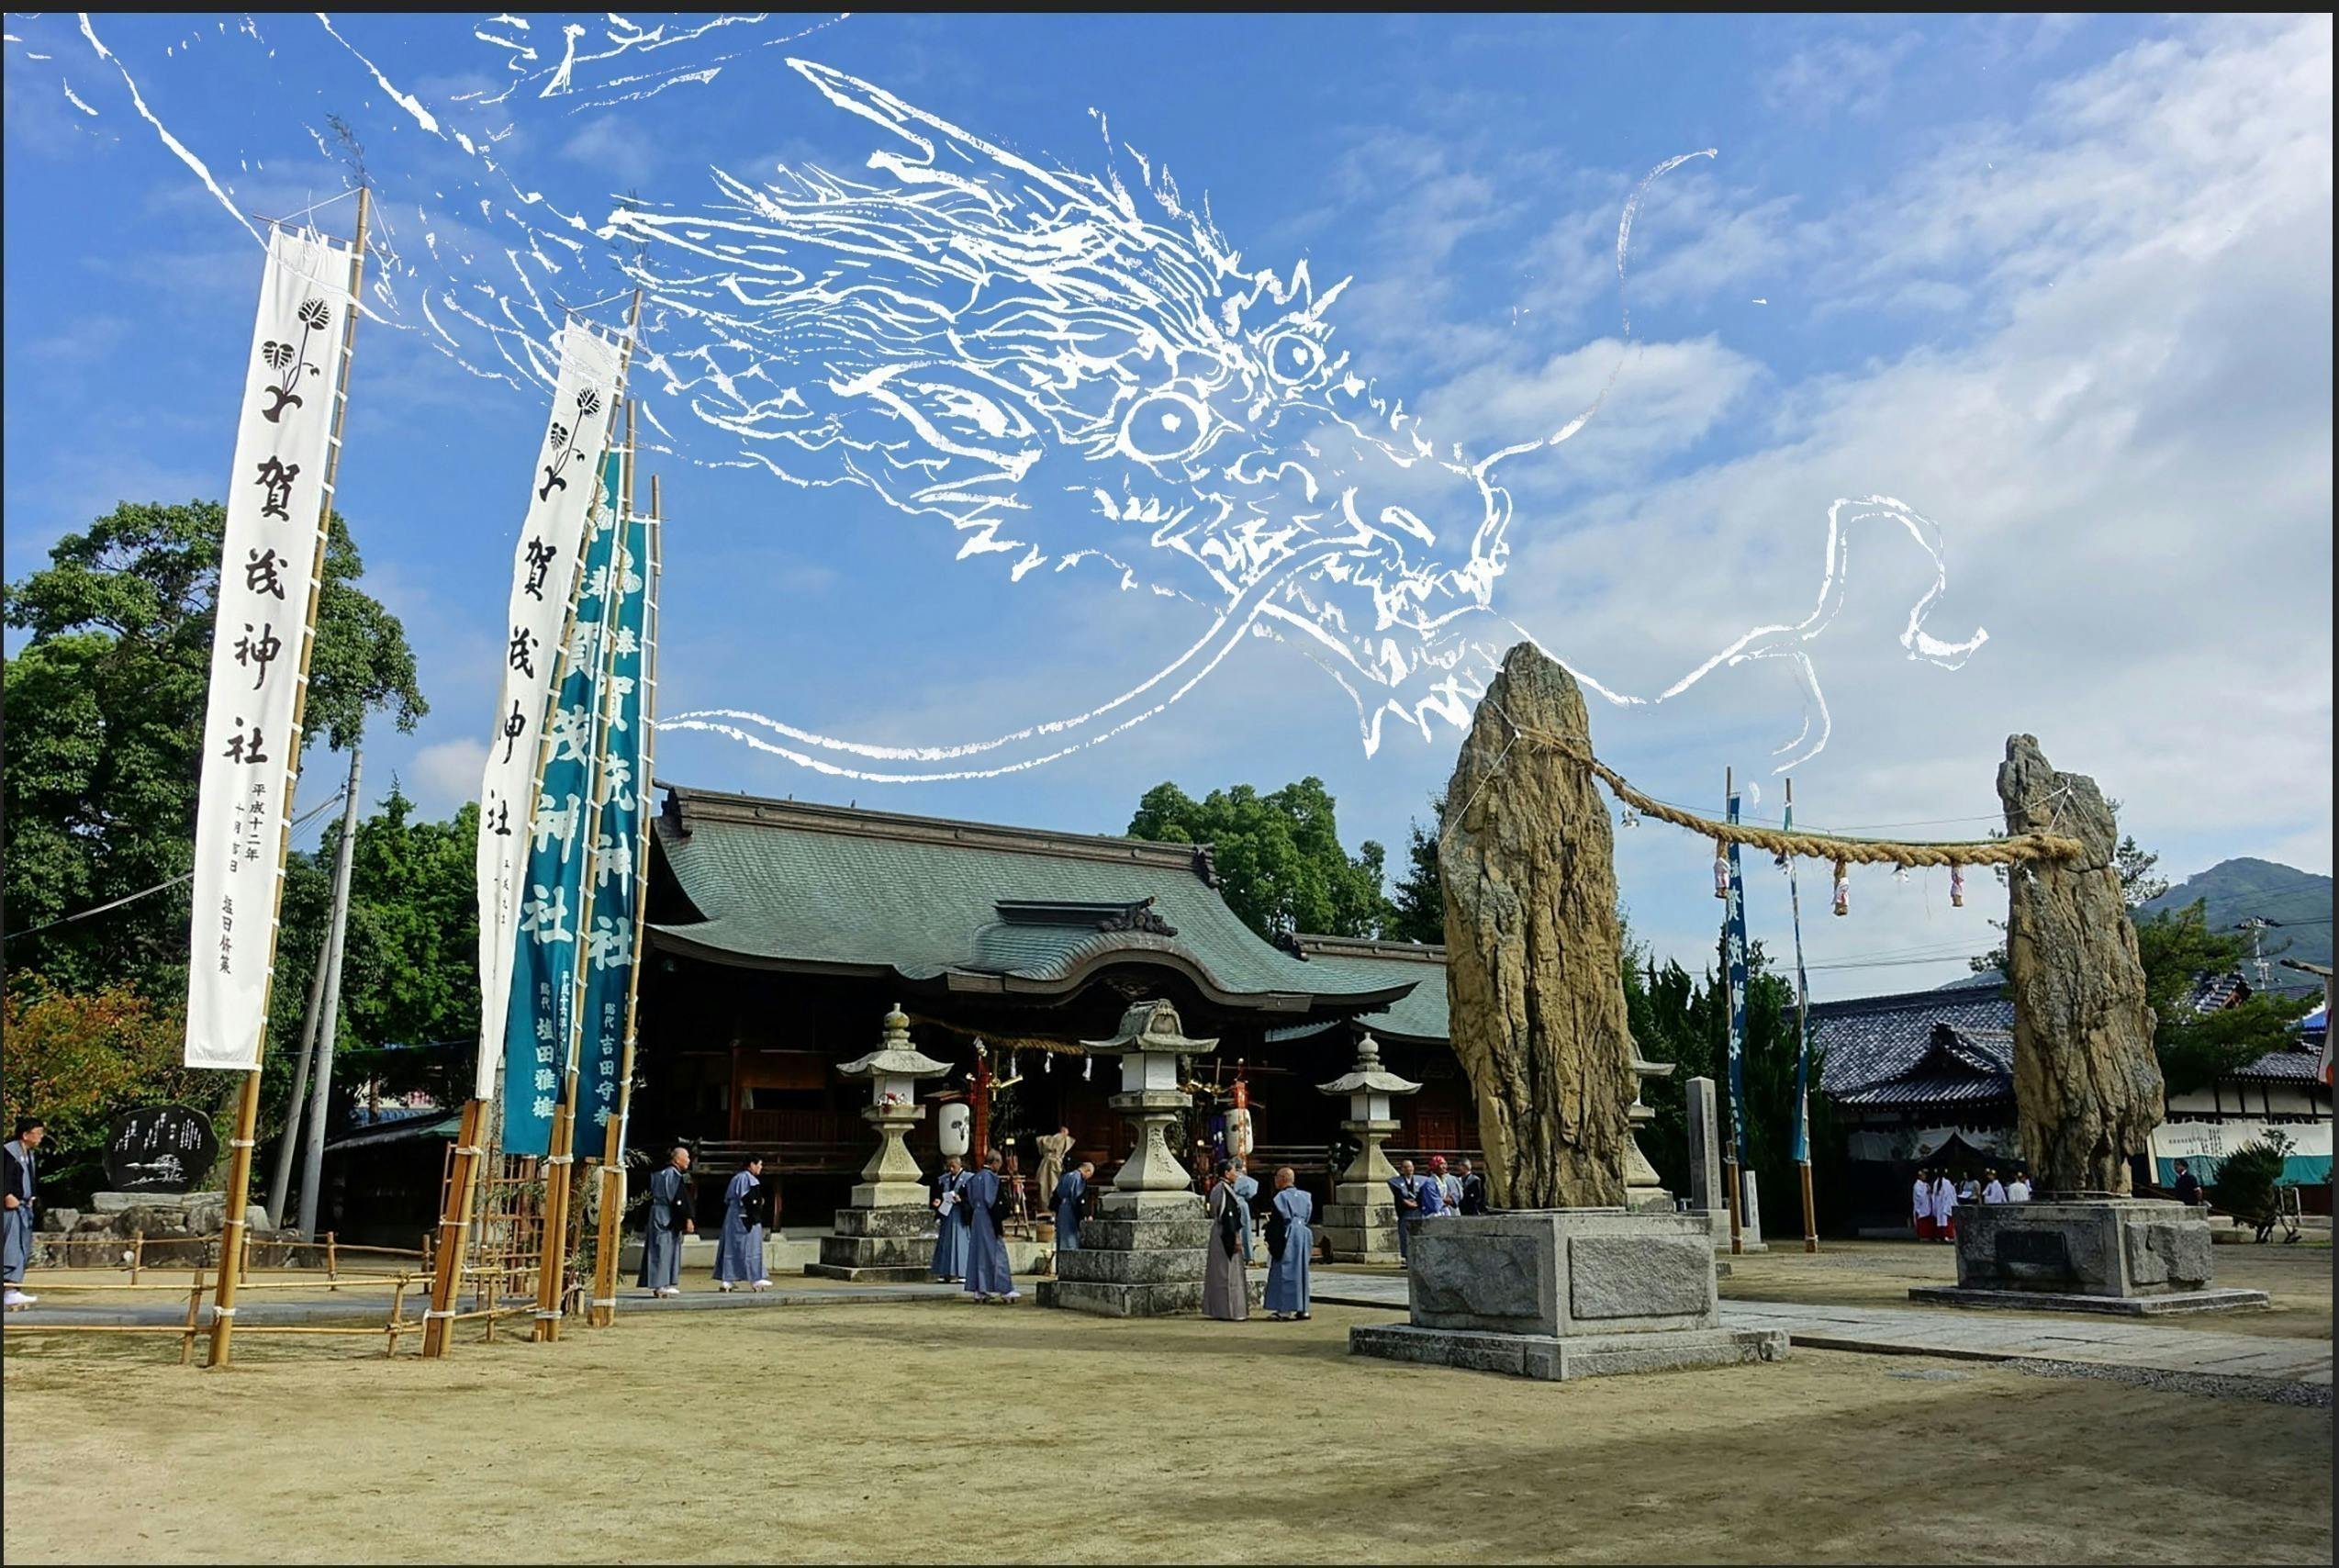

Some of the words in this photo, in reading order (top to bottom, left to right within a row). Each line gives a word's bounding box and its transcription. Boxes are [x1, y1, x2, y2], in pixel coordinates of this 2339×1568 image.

[222, 454, 300, 764] 賀茂神社
[244, 782, 267, 863] 平成十二年
[520, 622, 601, 946] 賀茂神社
[588, 673, 636, 971] 賀茂神社
